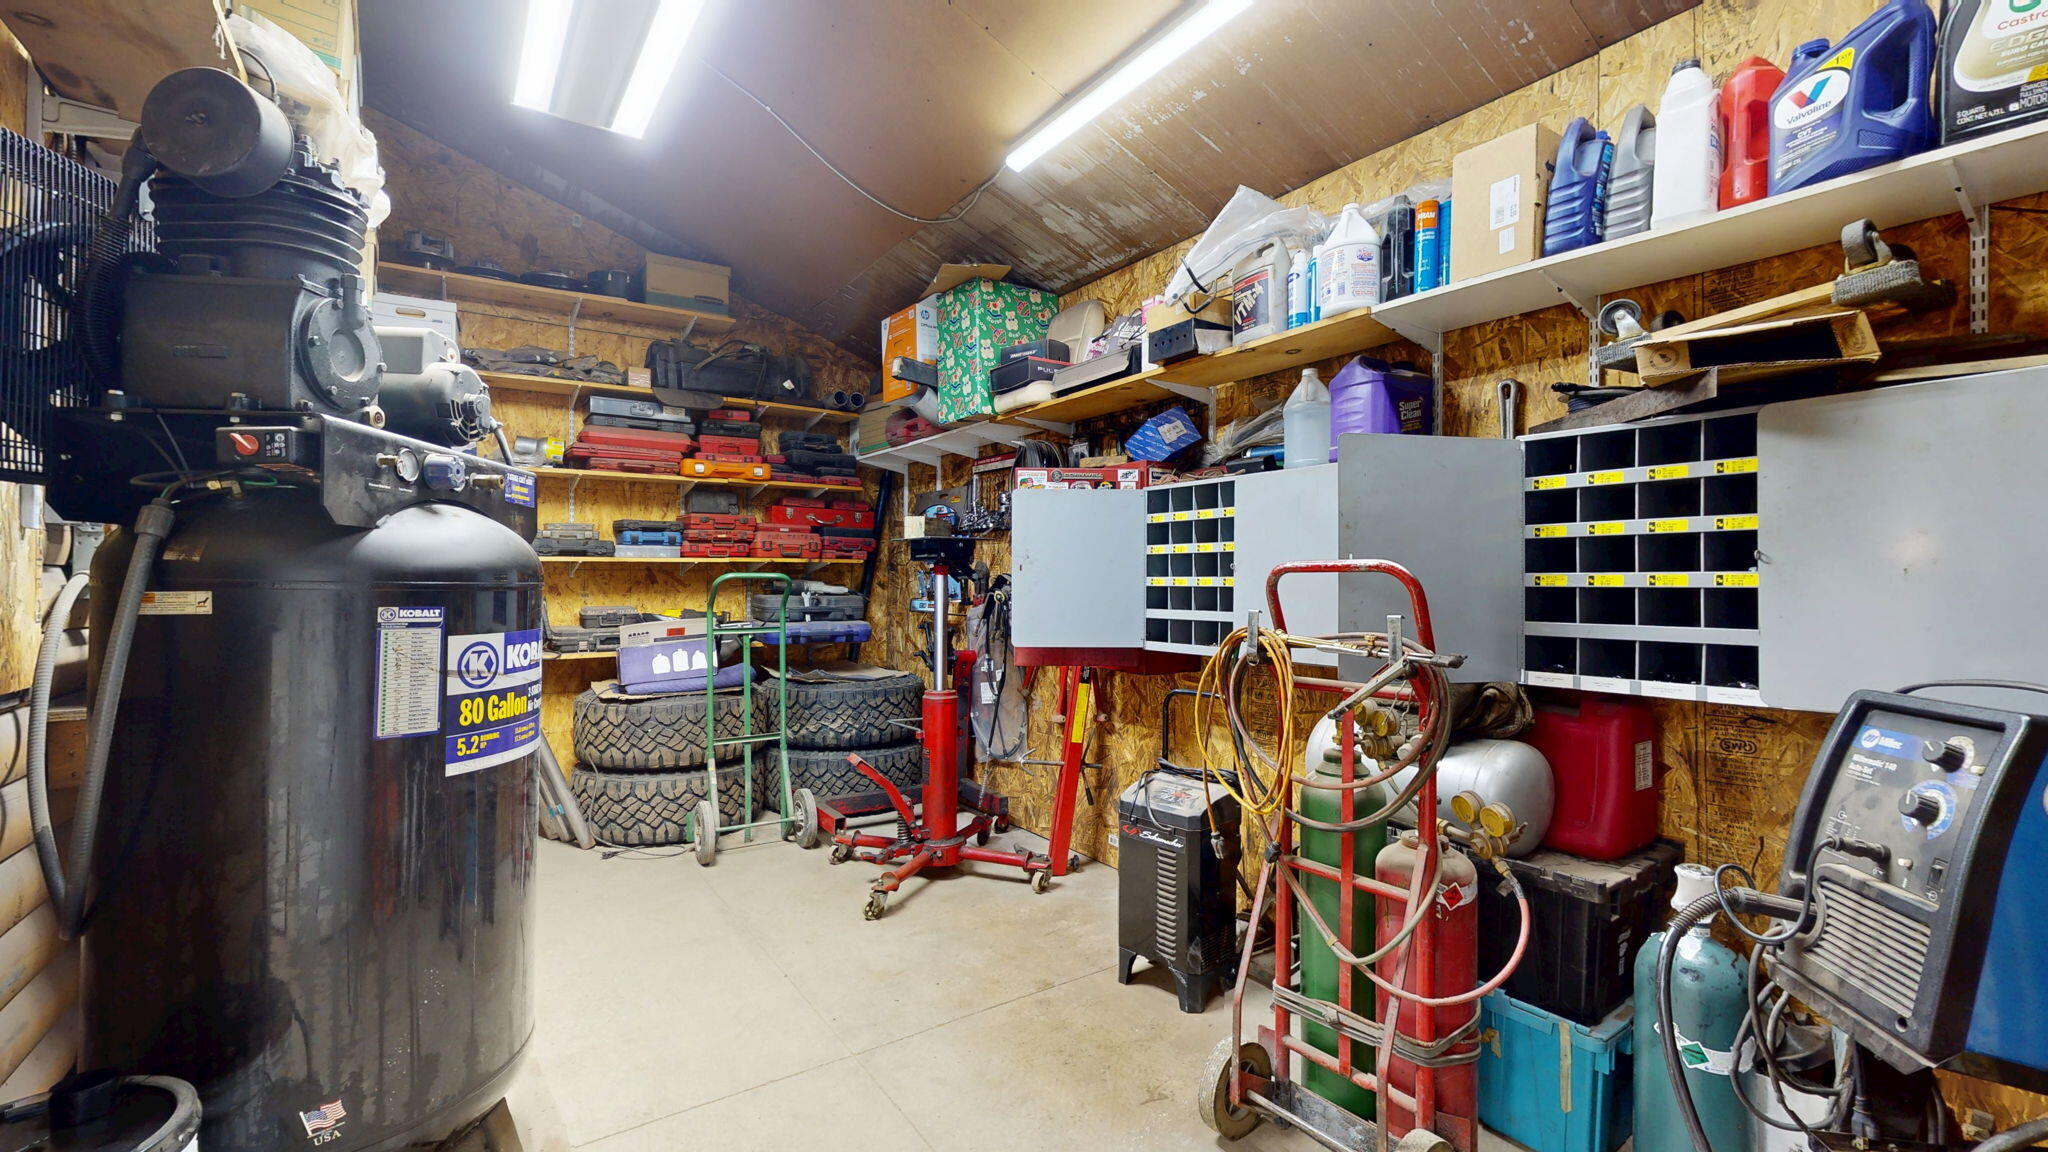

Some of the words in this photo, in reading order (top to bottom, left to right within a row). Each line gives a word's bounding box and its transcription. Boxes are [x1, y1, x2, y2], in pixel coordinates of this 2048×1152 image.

[1990, 27, 2048, 52] EDG
[1786, 100, 1832, 125] Valvoline
[1234, 282, 1264, 326] VTM-4
[1399, 400, 1422, 411] Super
[1400, 410, 1421, 420] Clean
[399, 609, 441, 618] KOBALT
[506, 640, 541, 669] KOB
[459, 698, 485, 726] 80
[487, 691, 528, 722] Gallon
[456, 736, 479, 757] 5.2
[313, 1130, 341, 1146] USA
